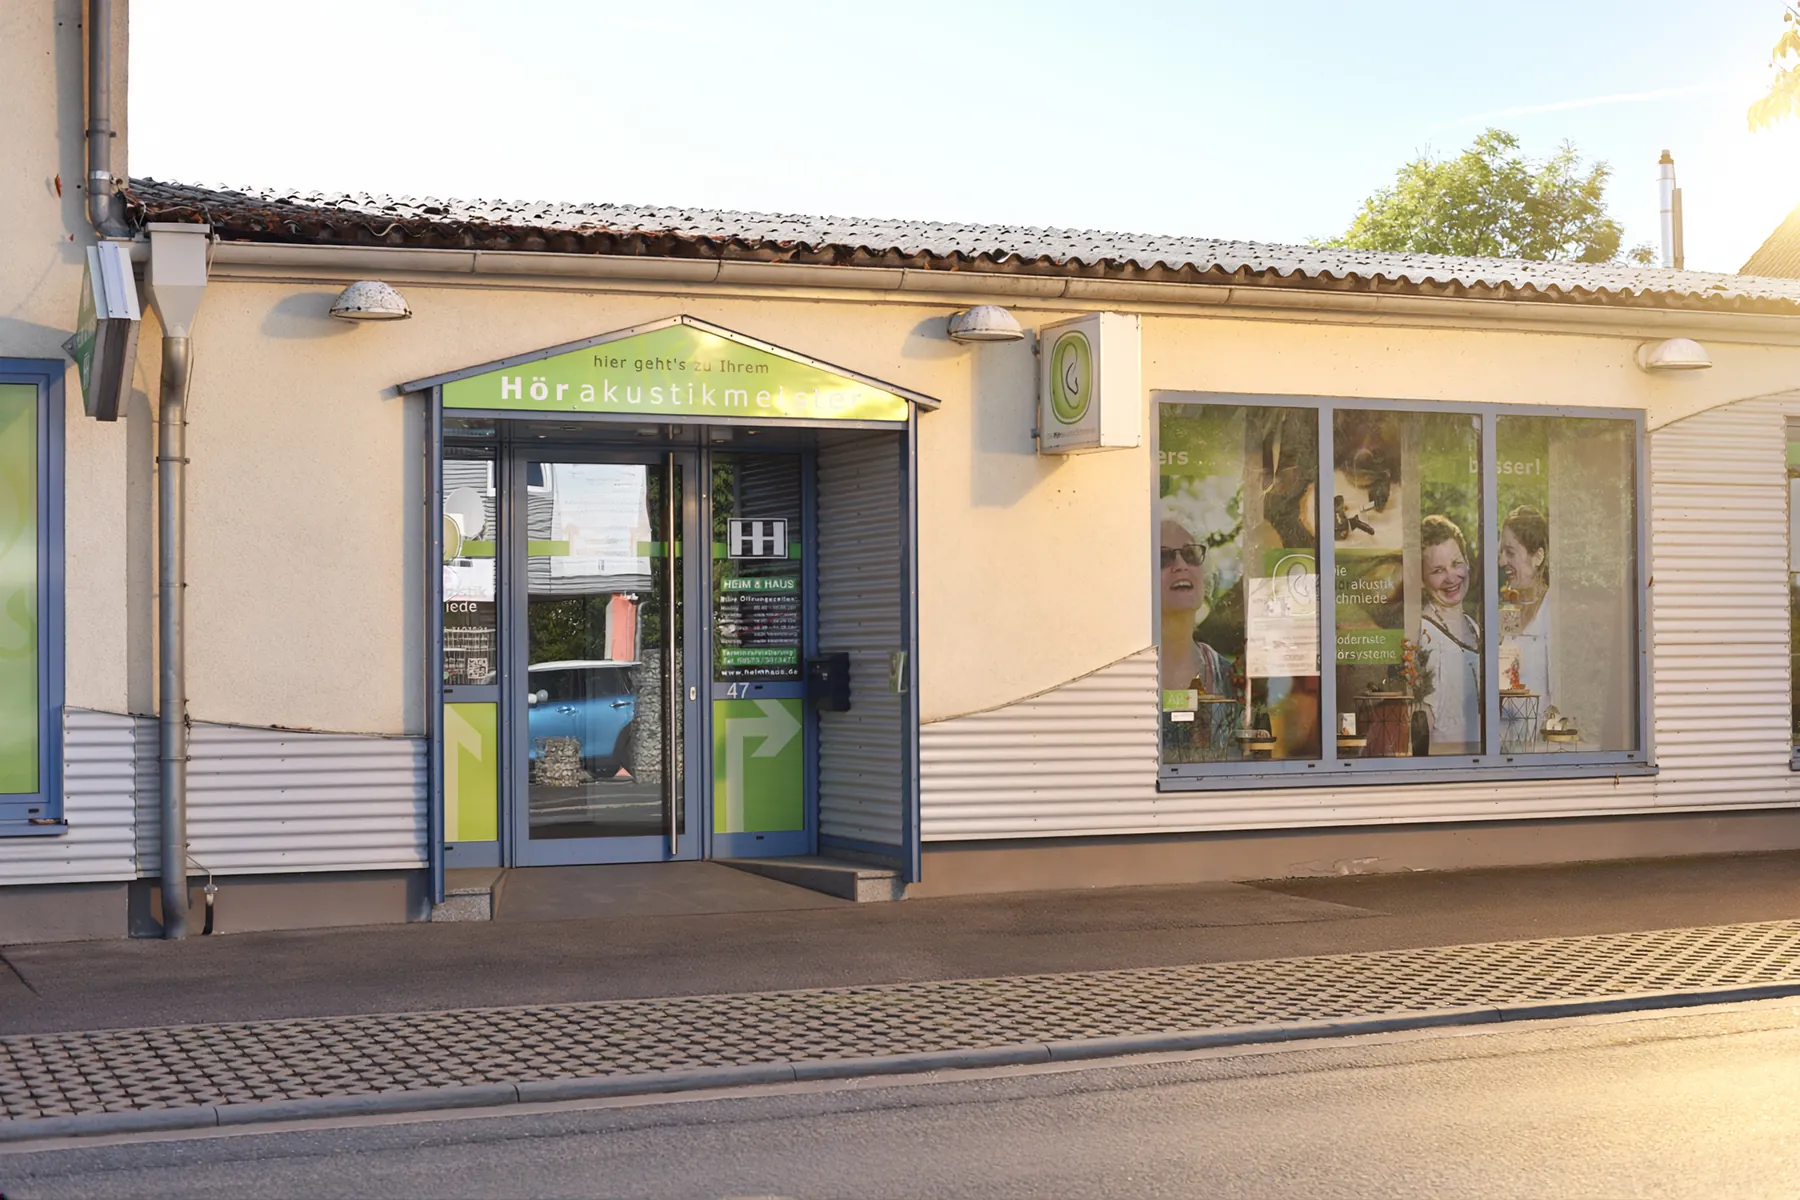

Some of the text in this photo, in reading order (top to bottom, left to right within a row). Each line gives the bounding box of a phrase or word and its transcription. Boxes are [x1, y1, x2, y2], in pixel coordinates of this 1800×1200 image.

[593, 355, 769, 374] hier geht's zu Ihrem
[501, 376, 863, 411] Hörakustikmeister
[1468, 456, 1541, 475] bsser!
[1335, 564, 1347, 576] ie
[723, 579, 752, 589] HEIM
[764, 579, 795, 589] HAUS
[1335, 592, 1388, 604] chmiede
[1336, 632, 1387, 645] odernste
[1336, 648, 1397, 661] örsysteme
[726, 682, 751, 699] 47
